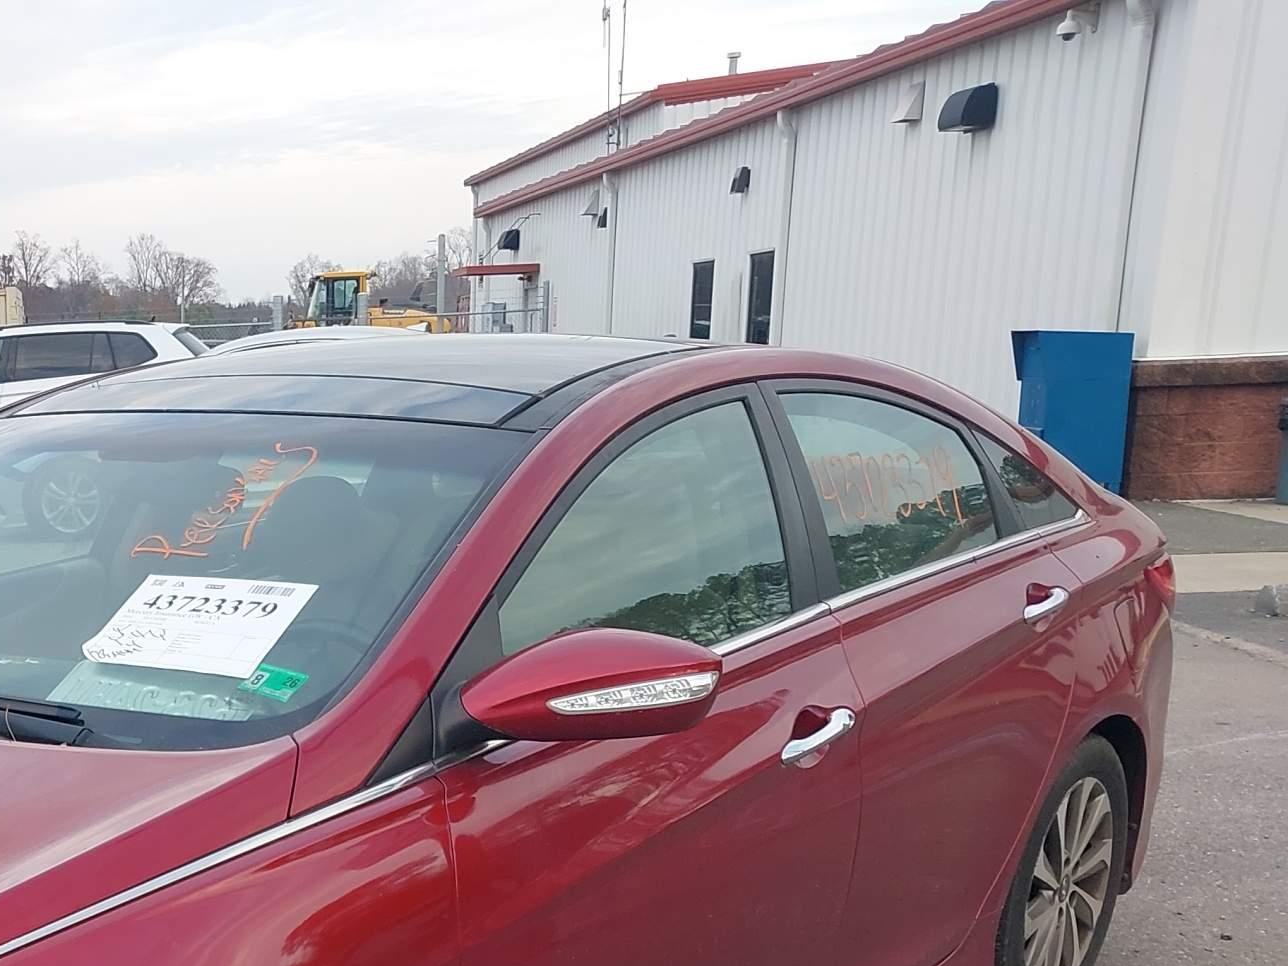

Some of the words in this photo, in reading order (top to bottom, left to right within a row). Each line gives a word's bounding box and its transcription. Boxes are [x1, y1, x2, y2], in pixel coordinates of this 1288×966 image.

[143, 594, 279, 619] 43723379
[251, 674, 265, 686] 8
[282, 677, 301, 689] 26
